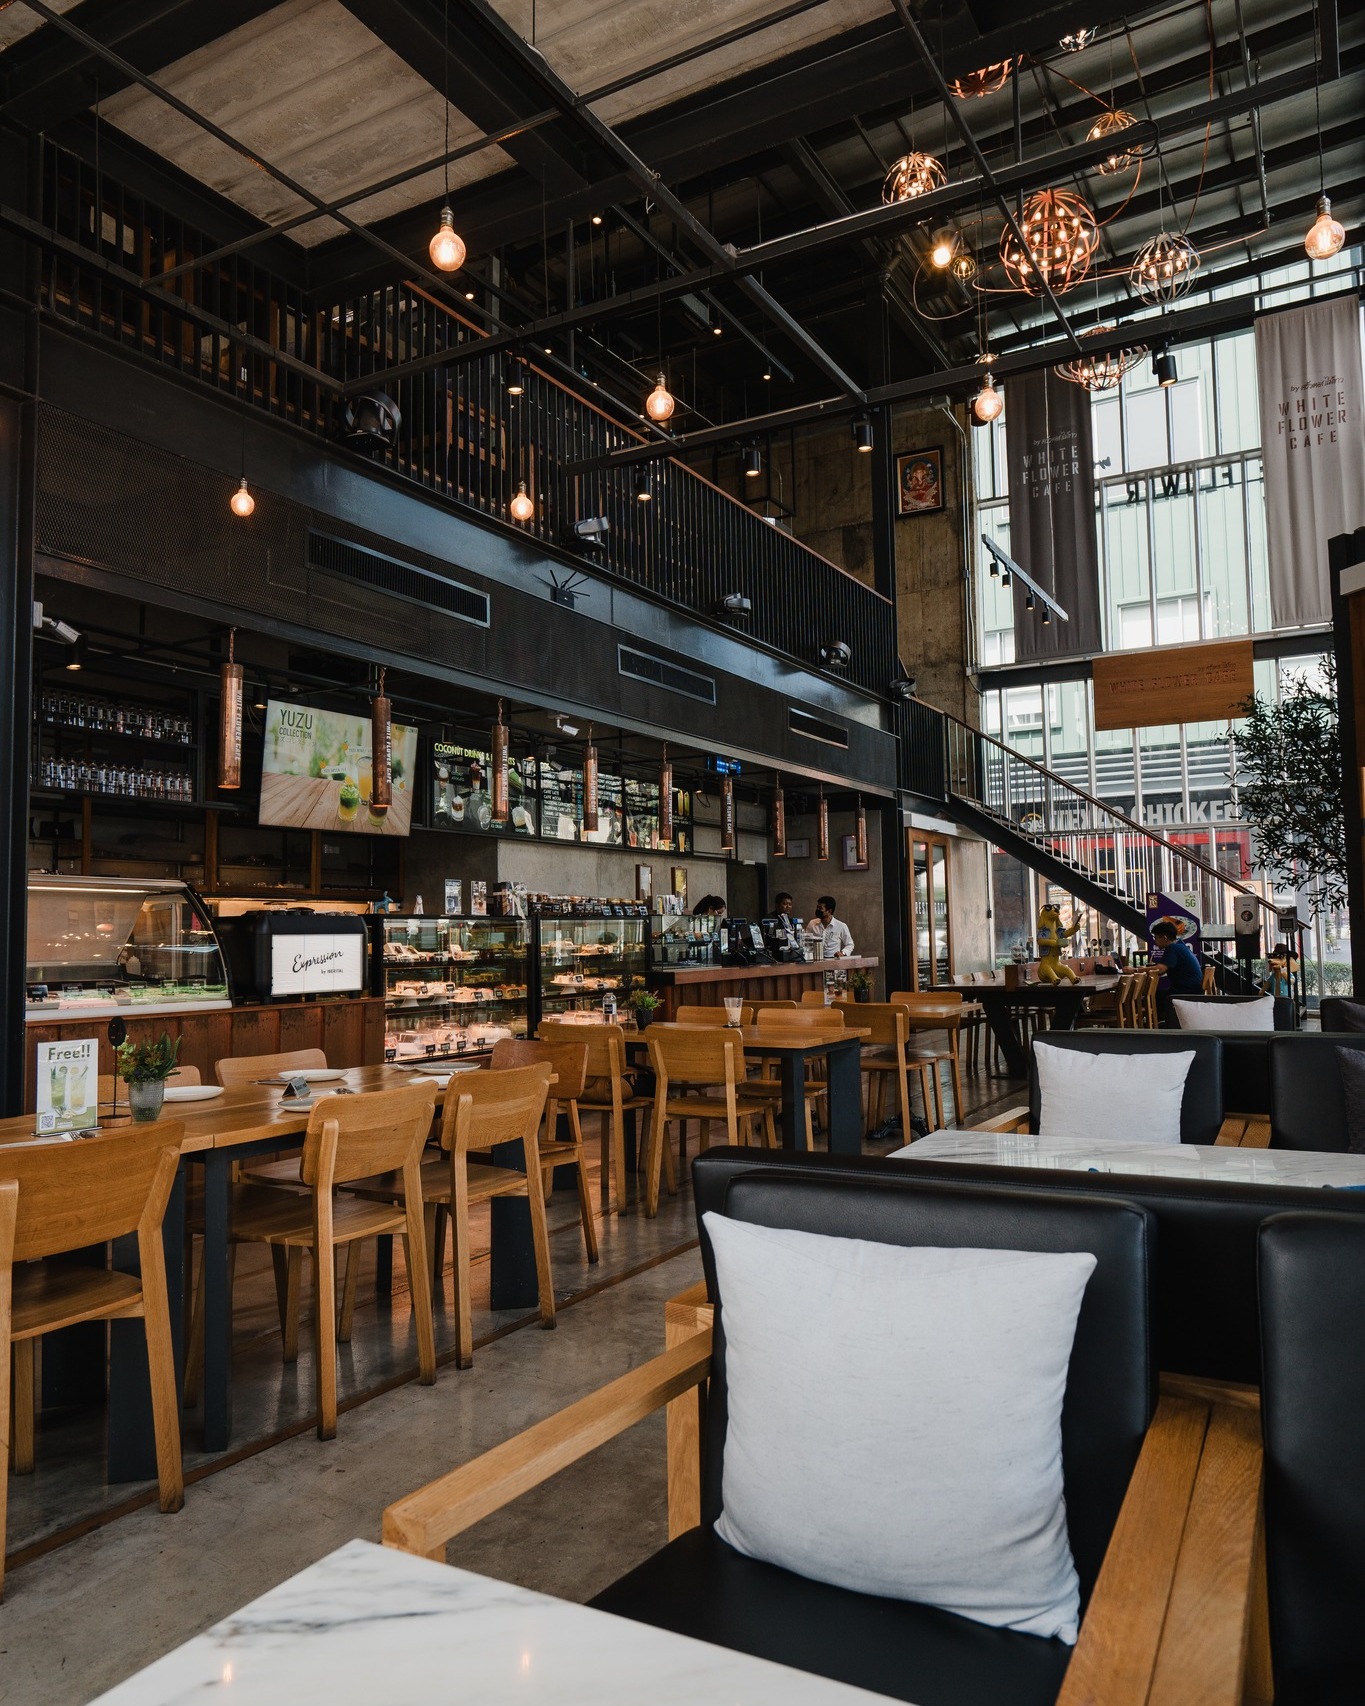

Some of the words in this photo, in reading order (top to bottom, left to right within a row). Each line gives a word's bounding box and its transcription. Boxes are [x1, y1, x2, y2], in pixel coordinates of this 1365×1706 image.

[1278, 391, 1345, 416] WHITE
[1278, 409, 1346, 435] FLOWER
[1289, 430, 1337, 449] CAFE
[1023, 445, 1078, 468] WHITE
[1022, 461, 1079, 485] FLOWER
[1032, 480, 1071, 498] CAFE
[279, 708, 314, 731] YUZU
[278, 726, 313, 740] COLLECTION
[434, 742, 464, 756] COCONUT
[1185, 898, 1196, 908] 5G
[292, 950, 344, 974] Expression
[48, 1044, 91, 1061] Free!!
